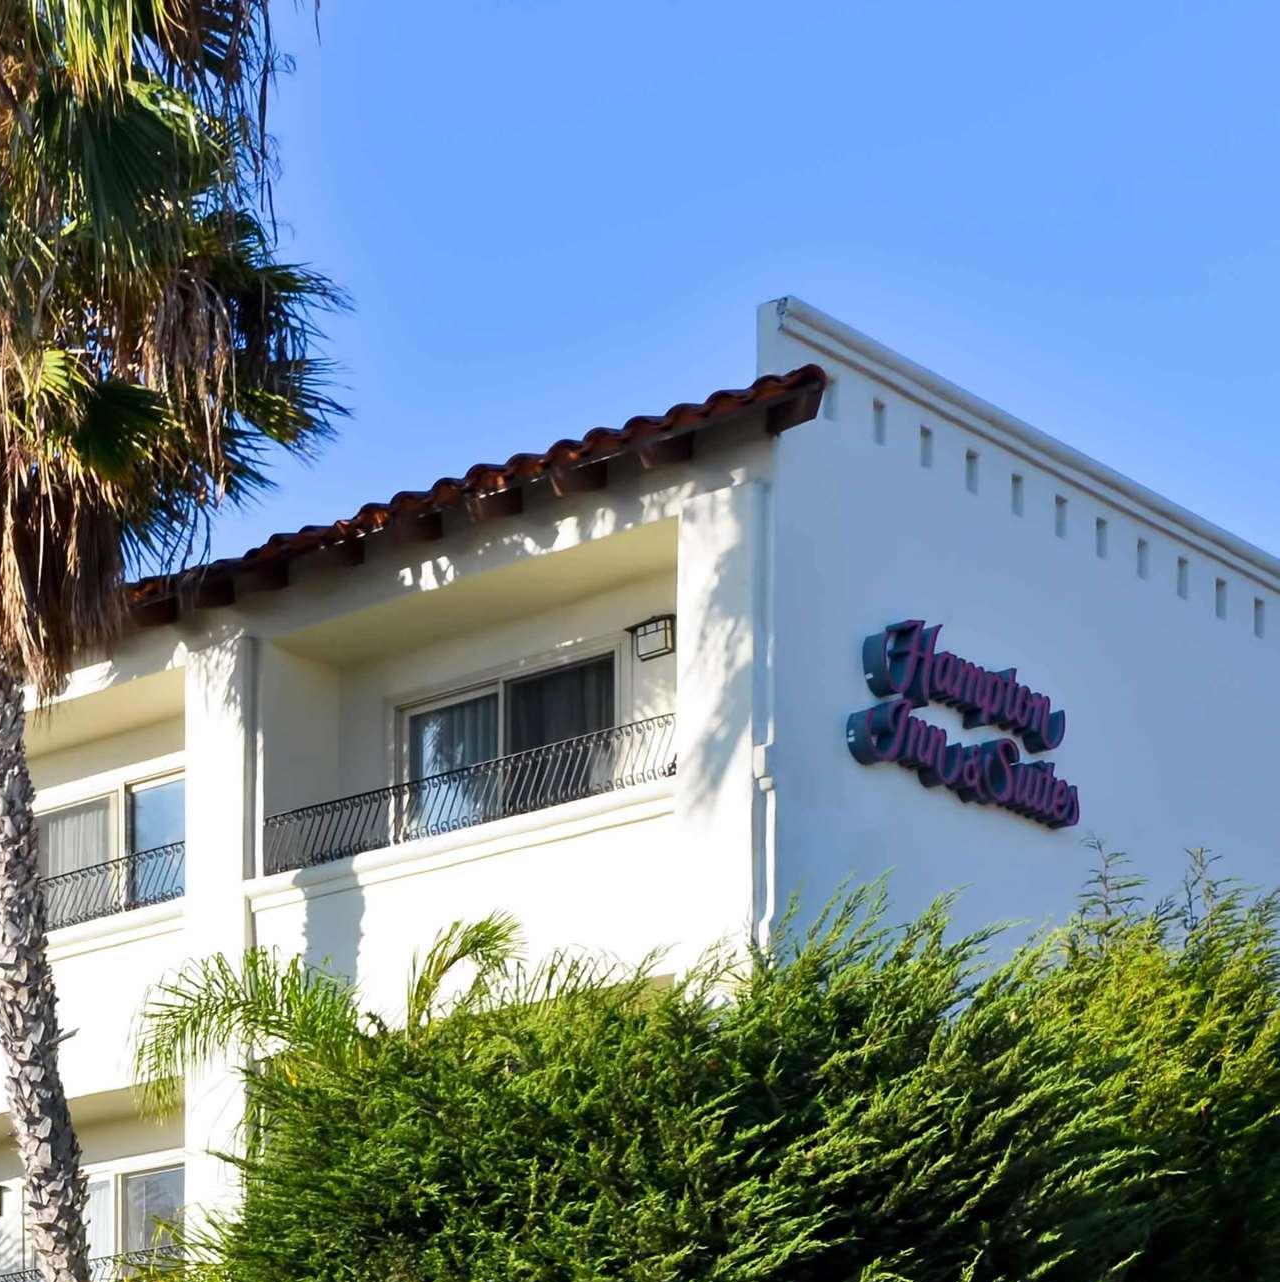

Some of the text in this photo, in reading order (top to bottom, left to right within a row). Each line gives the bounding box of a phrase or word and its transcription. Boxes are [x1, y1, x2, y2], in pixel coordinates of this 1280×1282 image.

[863, 619, 1066, 753] Hampton
[847, 699, 962, 787] Inn
[984, 738, 1080, 829] Suites
